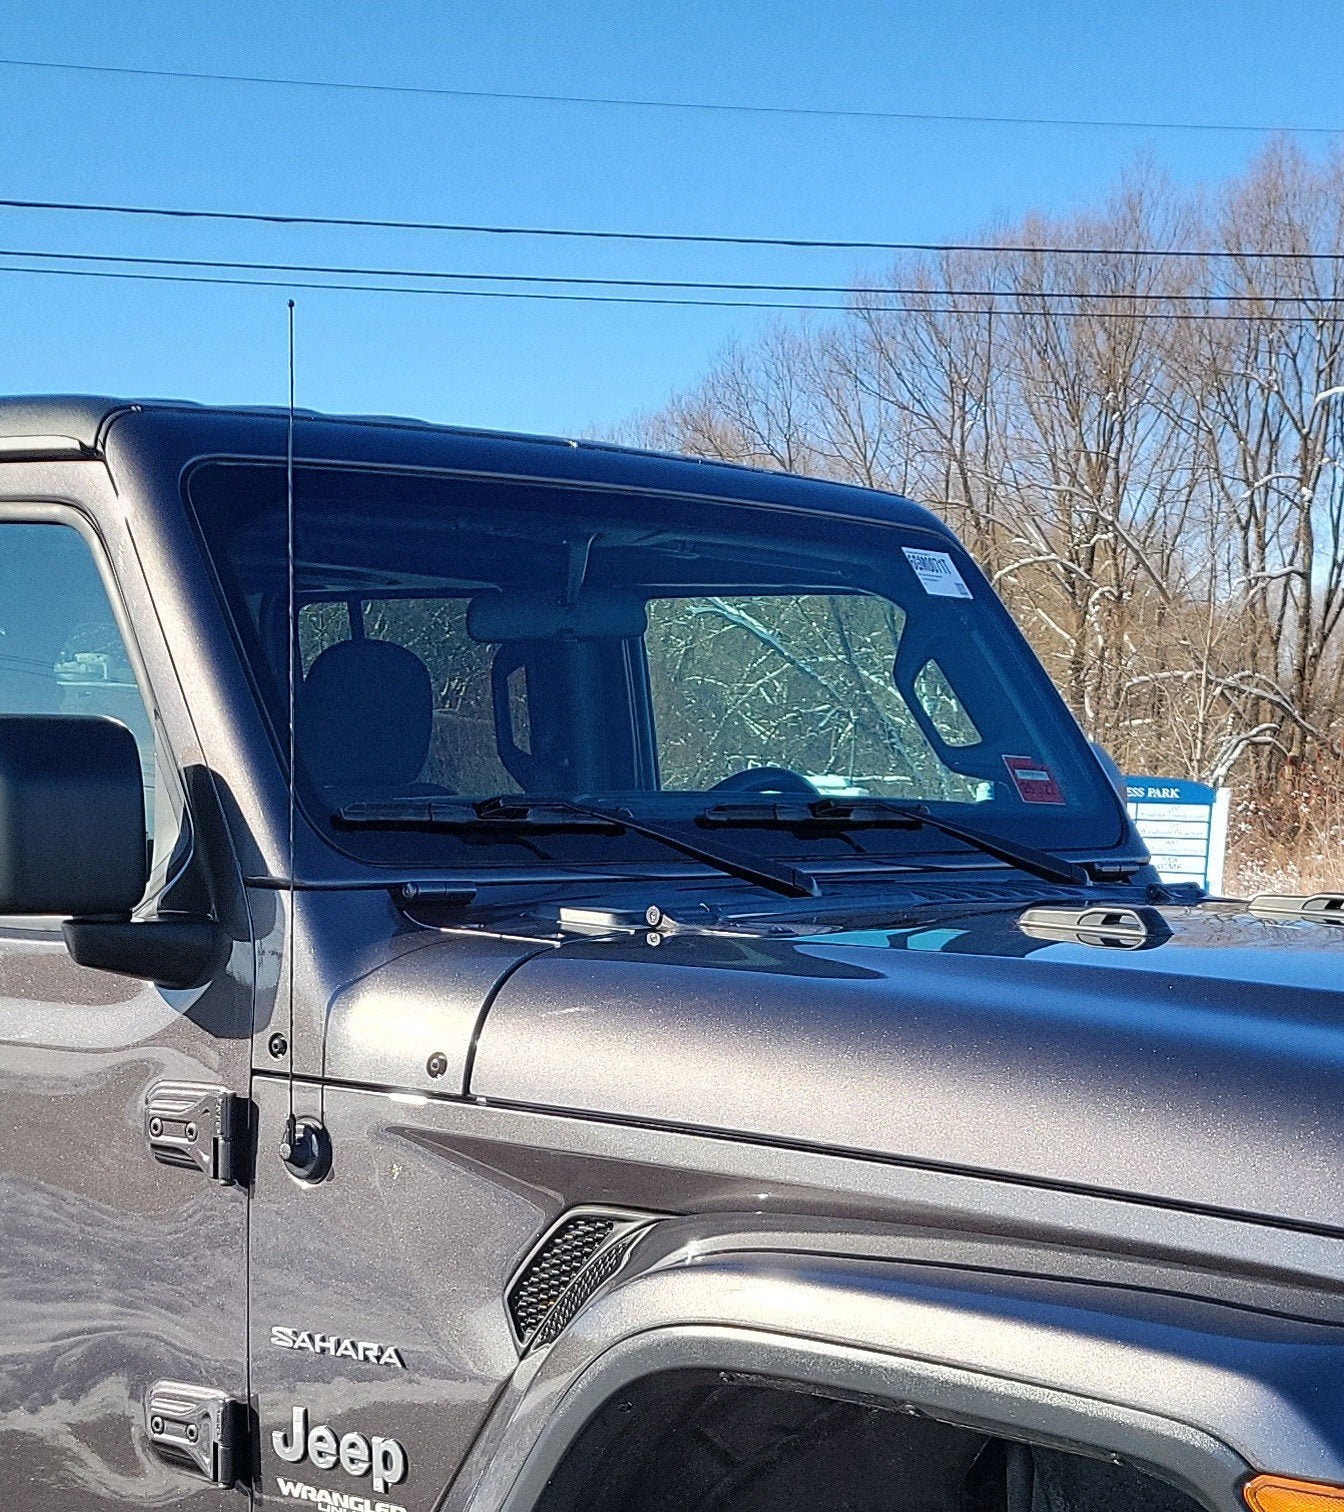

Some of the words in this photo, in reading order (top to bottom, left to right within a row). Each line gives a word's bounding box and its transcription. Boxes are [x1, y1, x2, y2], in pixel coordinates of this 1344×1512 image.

[1147, 787, 1180, 799] PARK
[269, 1325, 404, 1368] SAHARA
[271, 1405, 406, 1493] Jeep
